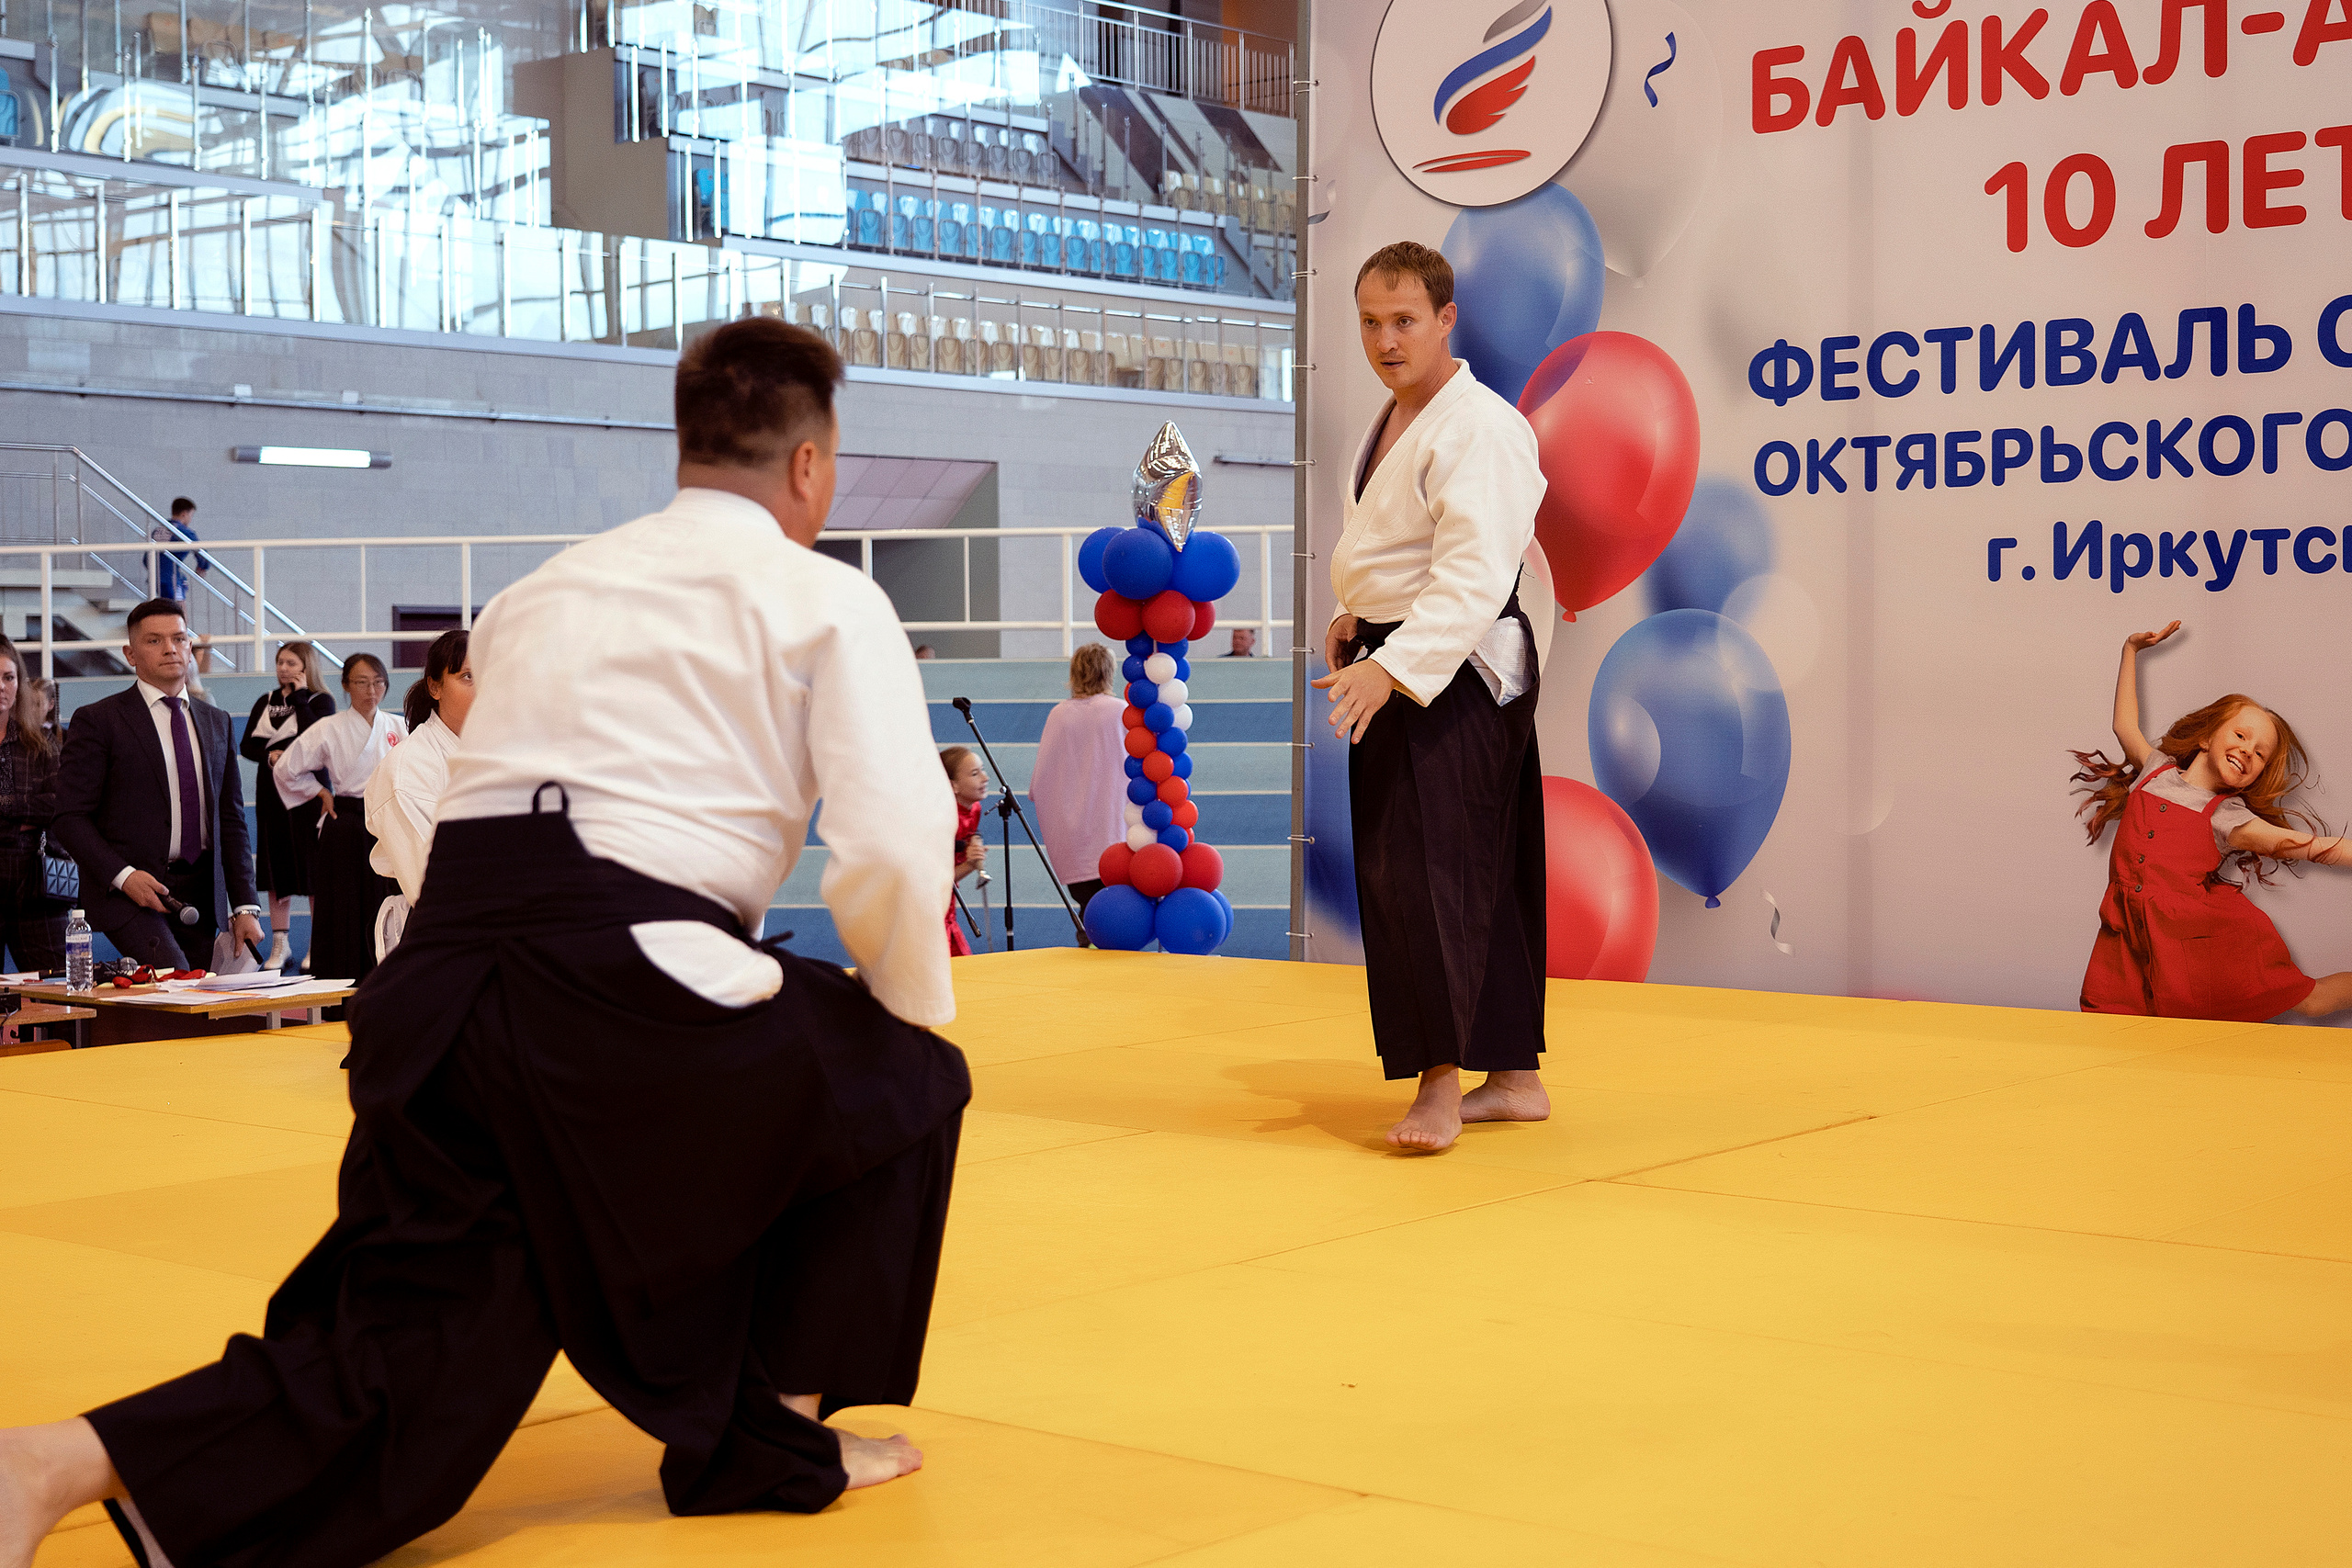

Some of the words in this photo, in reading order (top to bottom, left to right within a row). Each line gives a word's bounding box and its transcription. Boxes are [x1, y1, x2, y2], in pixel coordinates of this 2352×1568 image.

[1983, 152, 2117, 254] 10
[1747, 303, 2293, 407] ФЕСТИВАЛЬ
[1753, 408, 2352, 497] ОКТЯБРЬСКОГО
[2052, 520, 2352, 594] Иркутс
